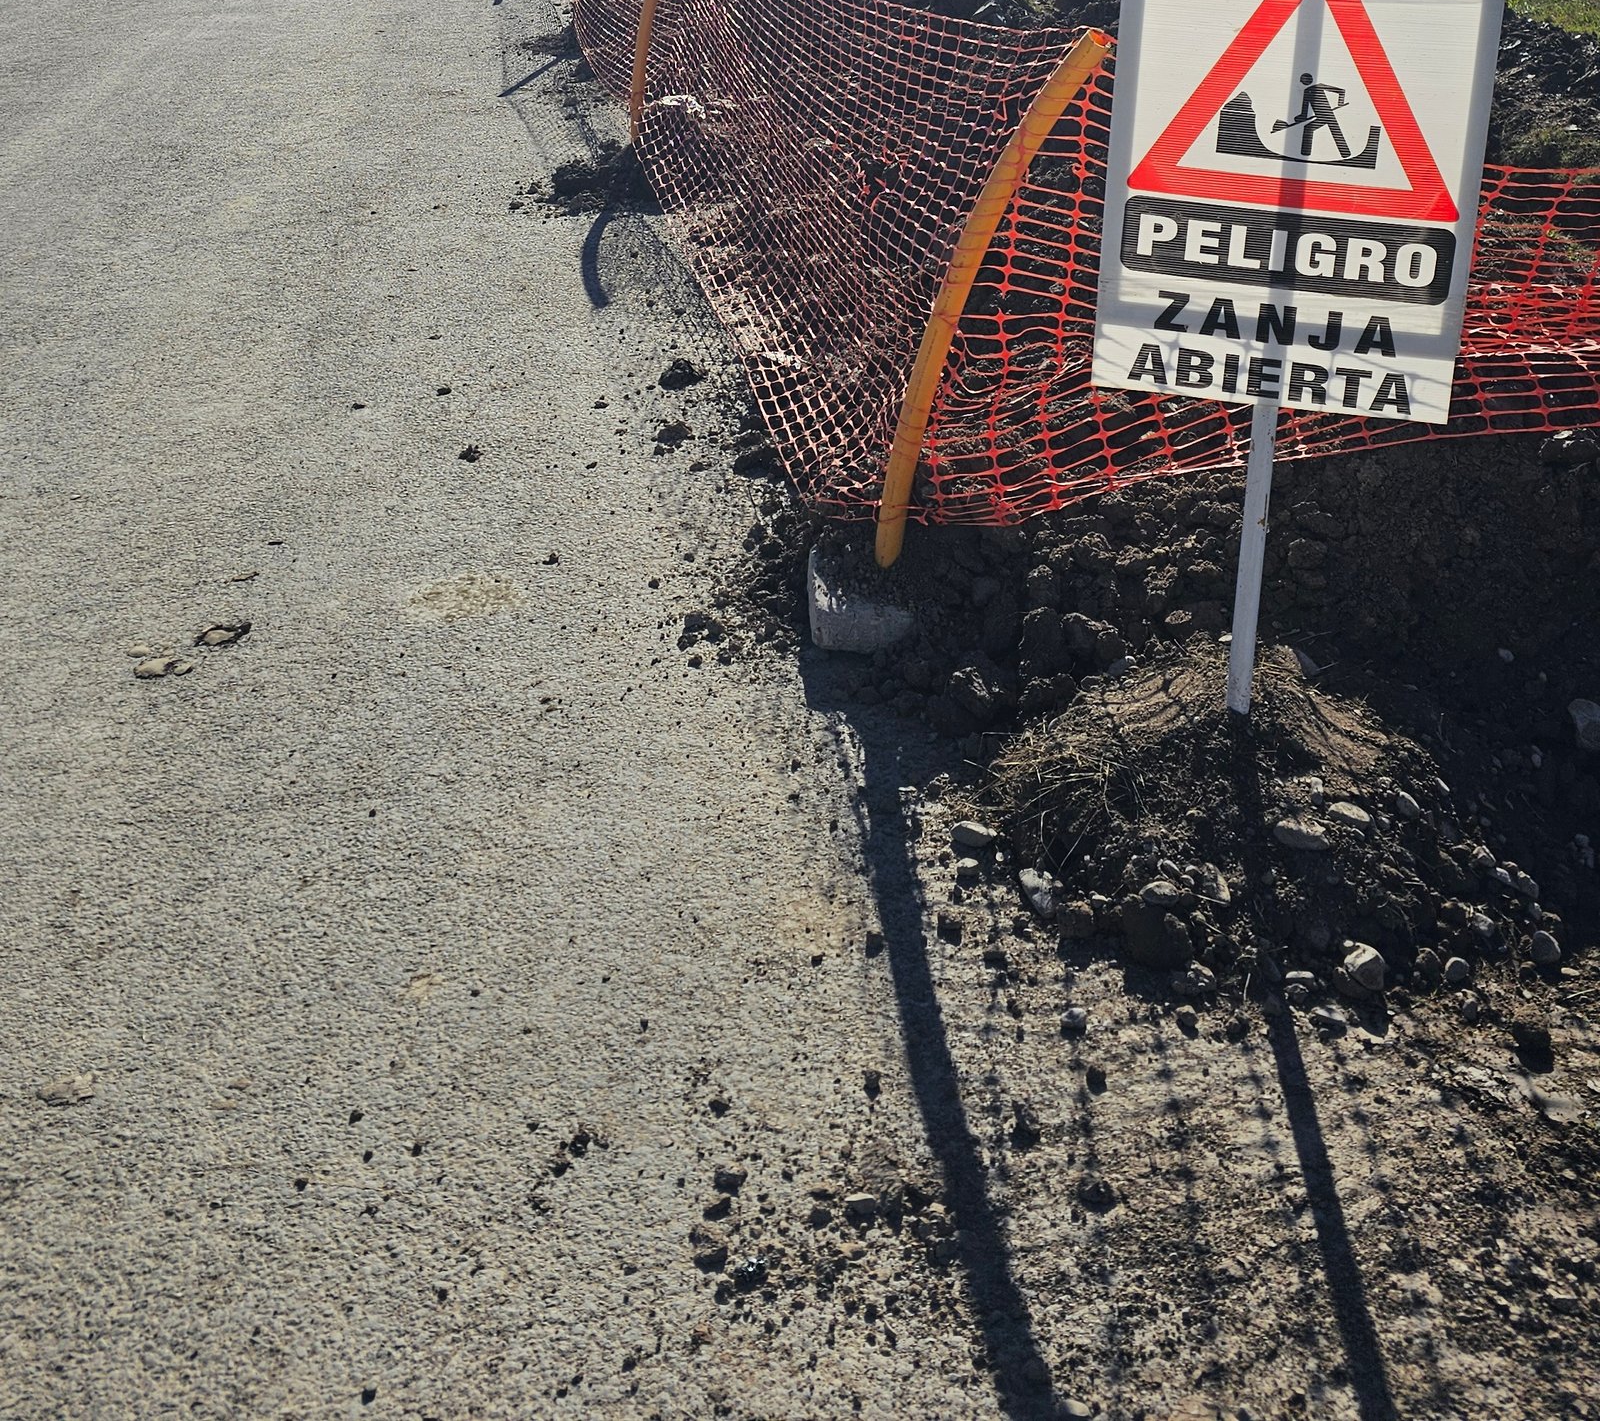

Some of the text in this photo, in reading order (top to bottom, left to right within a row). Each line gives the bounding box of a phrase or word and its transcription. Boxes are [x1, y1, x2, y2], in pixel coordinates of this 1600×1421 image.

[1136, 214, 1437, 287] PELIGRO
[1154, 290, 1396, 357] ZANJA
[1128, 343, 1411, 415] ABIERTA
